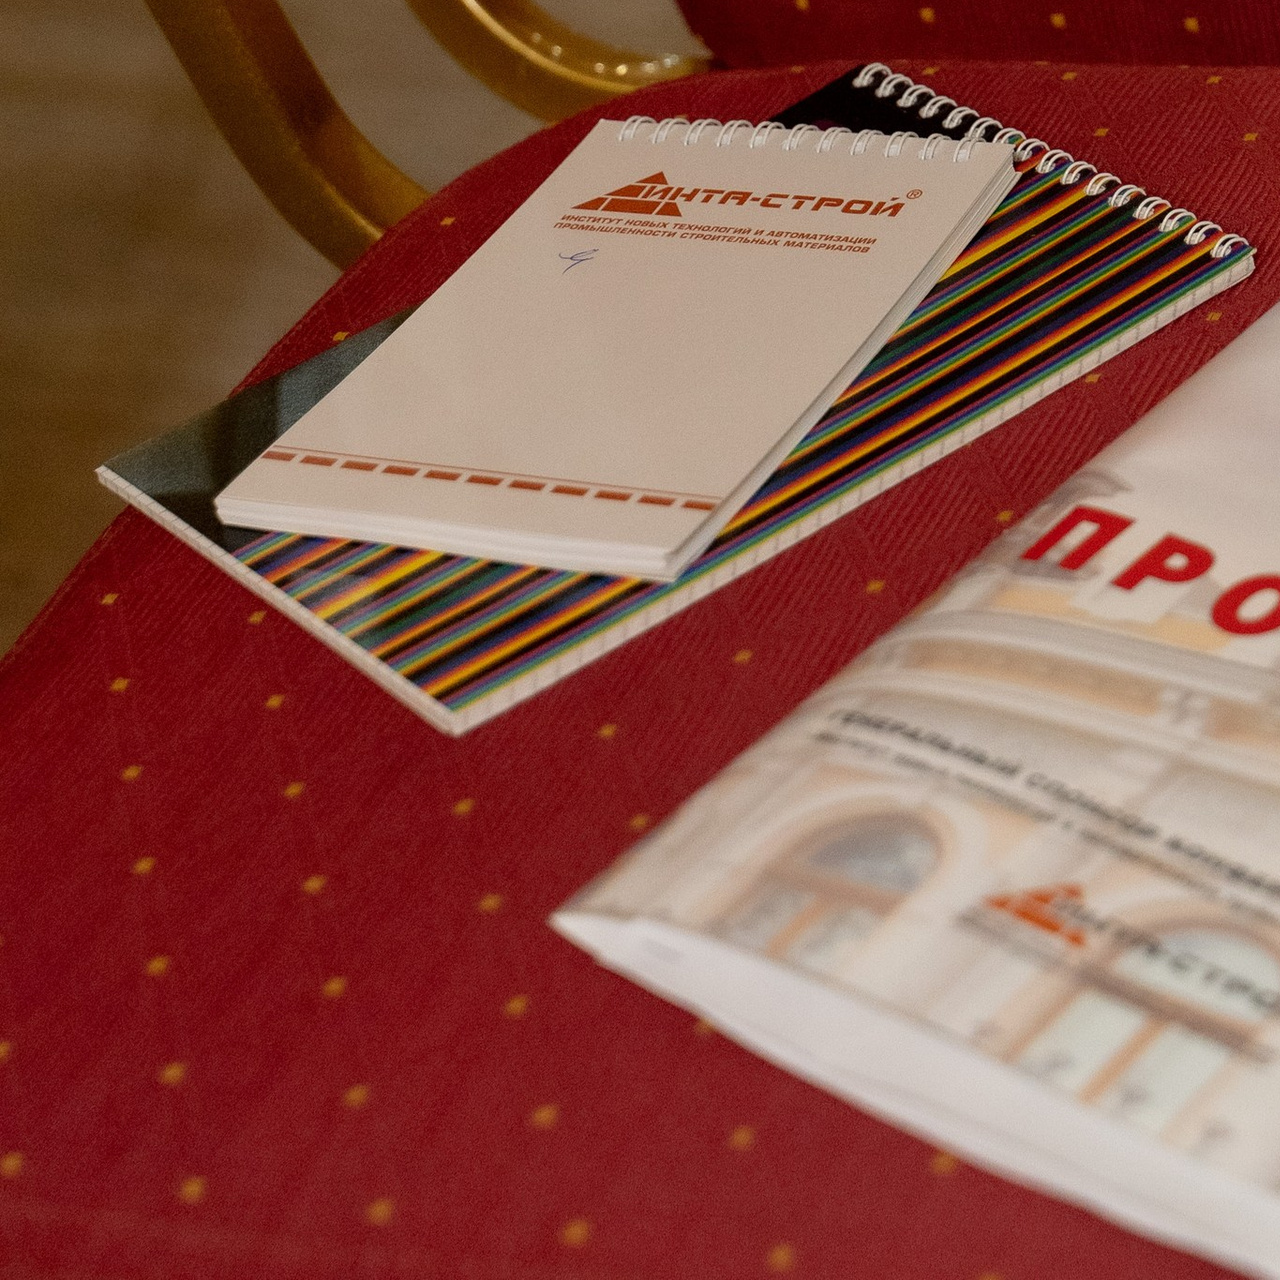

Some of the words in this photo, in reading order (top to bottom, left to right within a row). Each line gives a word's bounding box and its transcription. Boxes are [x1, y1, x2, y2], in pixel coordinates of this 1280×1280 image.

[553, 222, 677, 238] ПРОМЫШЛЕННОСТИ
[679, 231, 780, 247] СТРОИТЕЛЬНЫХ
[782, 240, 870, 254] МАТЕРИАЛОВ
[560, 214, 623, 225] ИНСТИТУТ
[624, 218, 669, 230] НОВЫХ
[672, 222, 752, 236] ТЕХНОЛОГИЙ
[753, 228, 764, 237] И
[766, 230, 878, 246] АВТОМАТИЗАЦИИ
